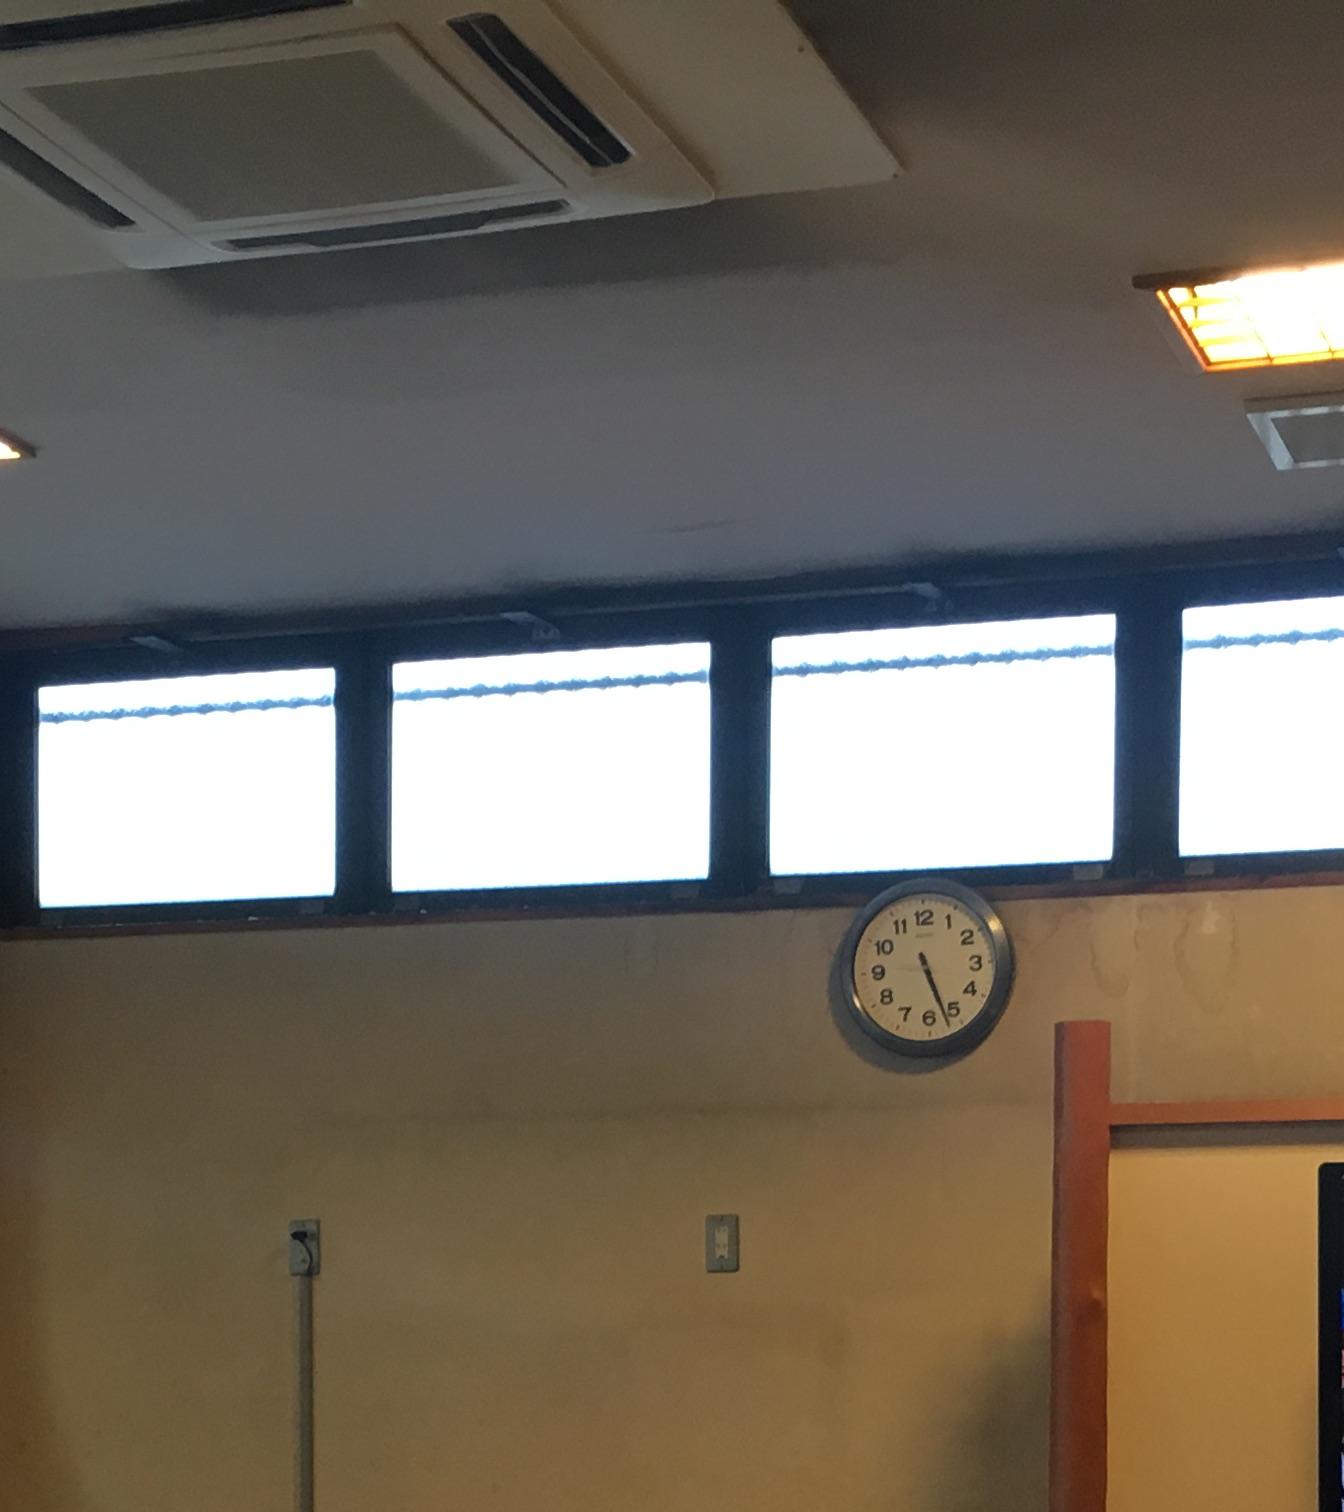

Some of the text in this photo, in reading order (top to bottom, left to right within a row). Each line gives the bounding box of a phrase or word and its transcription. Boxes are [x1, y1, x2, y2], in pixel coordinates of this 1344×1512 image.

[914, 909, 934, 926] 12
[945, 914, 952, 929] 1
[893, 918, 907, 935] 11
[960, 929, 975, 946] 2
[874, 939, 894, 956] 10
[968, 955, 982, 971] 3
[871, 964, 885, 981] 9
[880, 988, 894, 1005] 8
[962, 980, 977, 997] 4
[898, 1006, 912, 1022] 7
[947, 1001, 960, 1017] 5
[922, 1010, 936, 1026] 6
